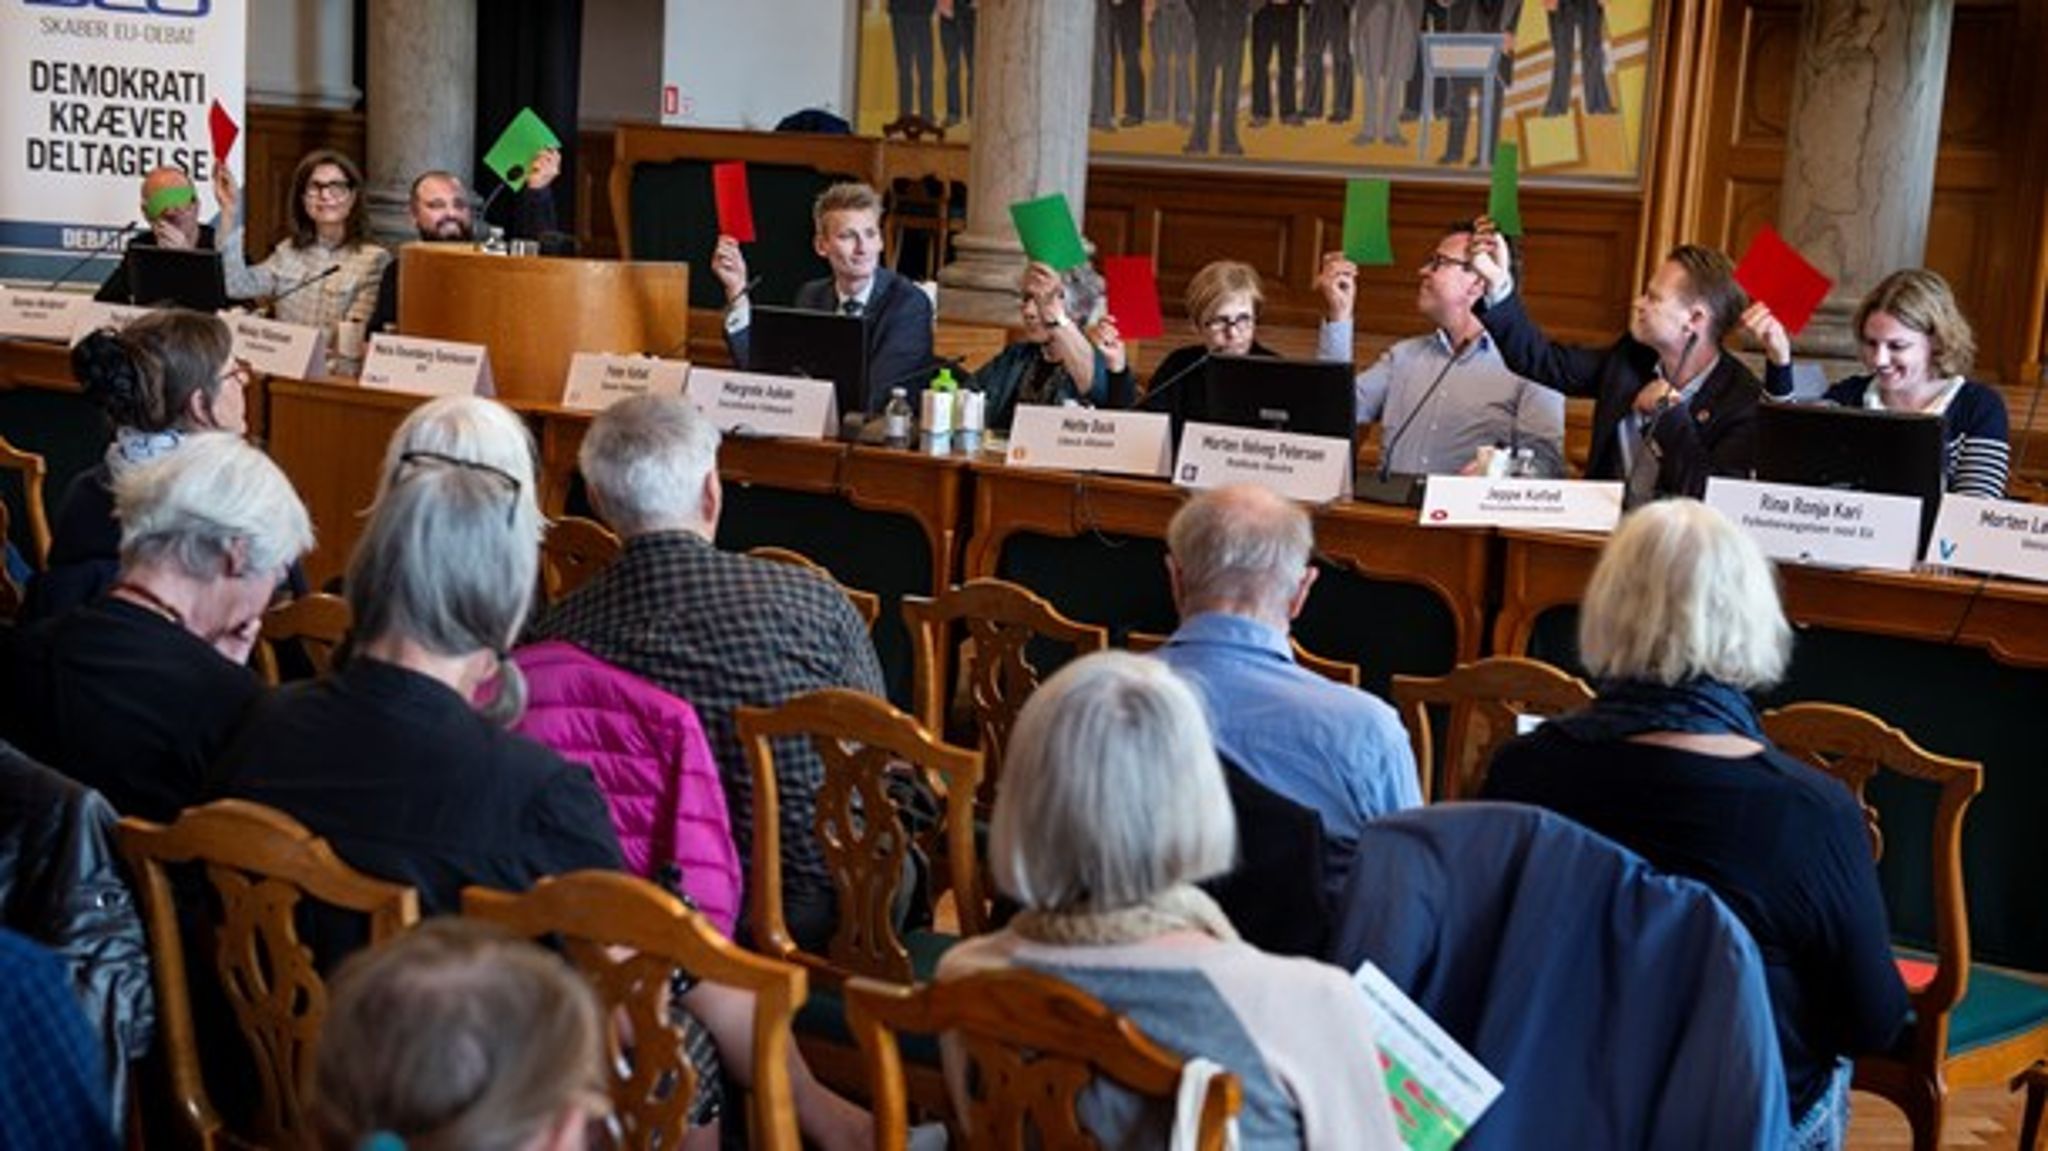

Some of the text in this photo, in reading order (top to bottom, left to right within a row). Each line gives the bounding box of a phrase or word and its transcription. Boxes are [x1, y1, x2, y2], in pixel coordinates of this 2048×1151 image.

[30, 59, 206, 104] DEMOKRATI
[49, 100, 188, 142] KRÆVER
[1981, 509, 2029, 531] Morten
